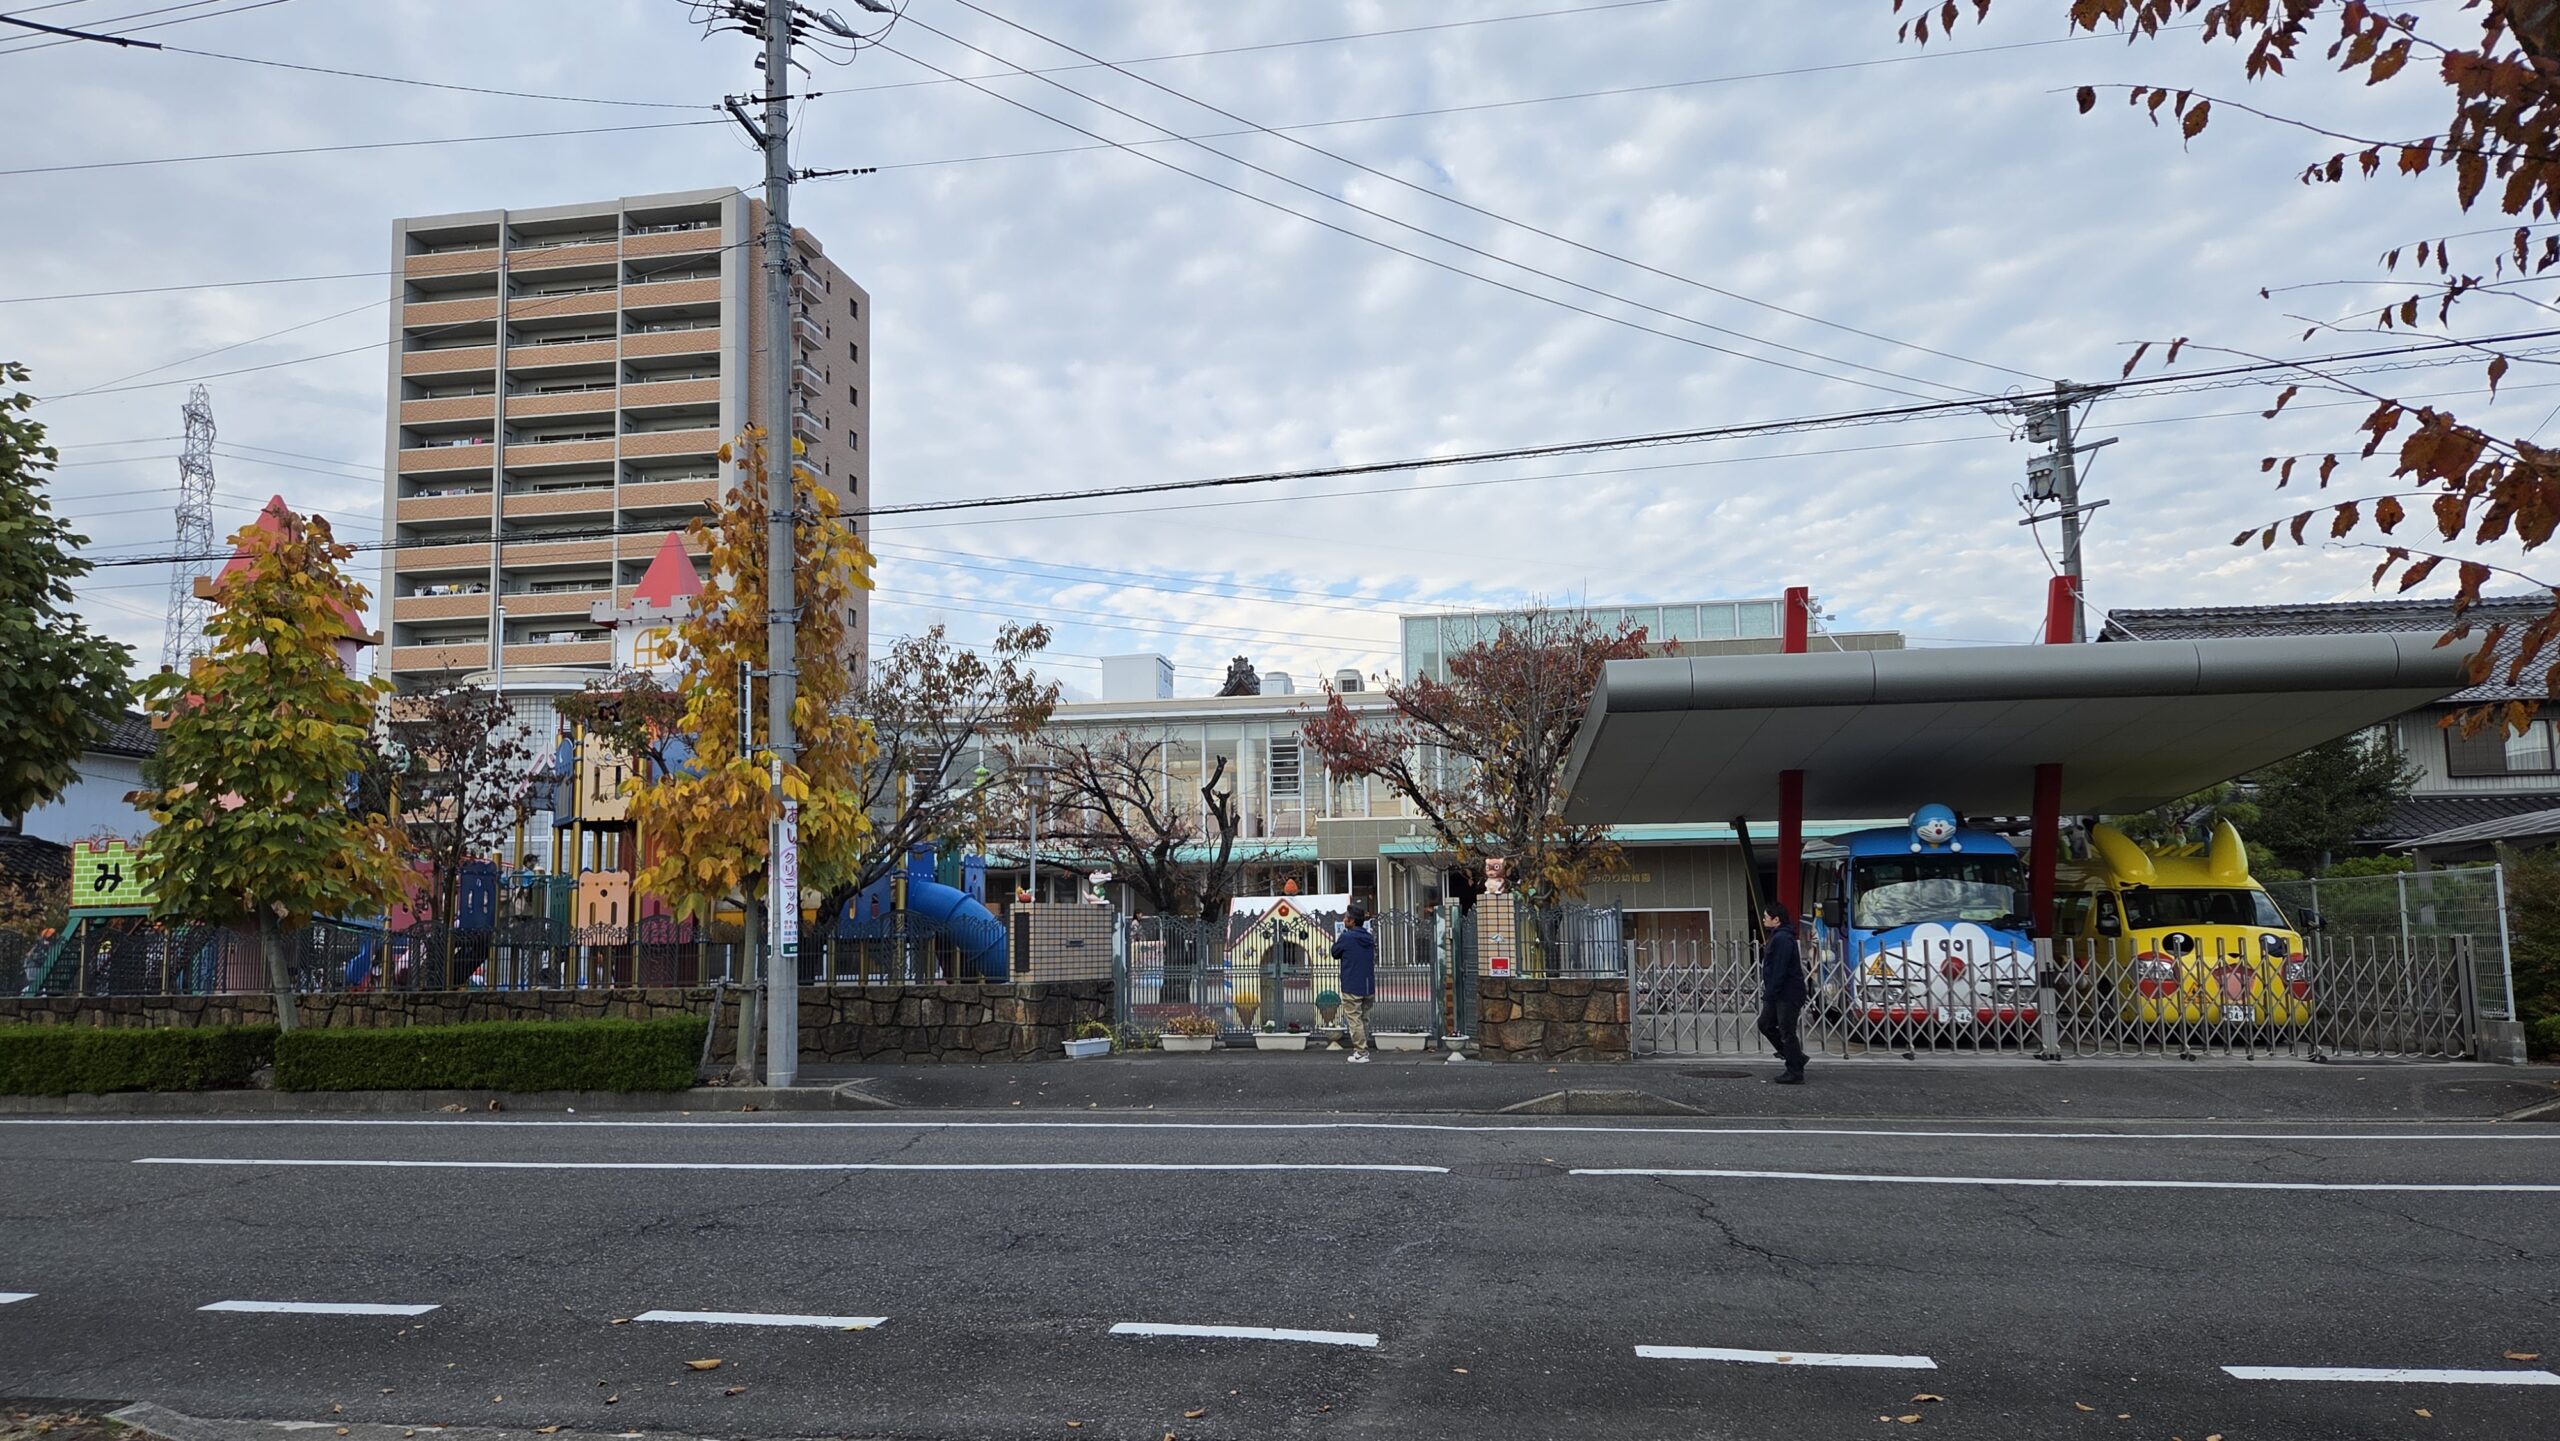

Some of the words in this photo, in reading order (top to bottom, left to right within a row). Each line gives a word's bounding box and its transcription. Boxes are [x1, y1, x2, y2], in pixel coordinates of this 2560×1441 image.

[94, 863, 123, 893] み
[1592, 873, 1651, 883] みのり幼稚園
